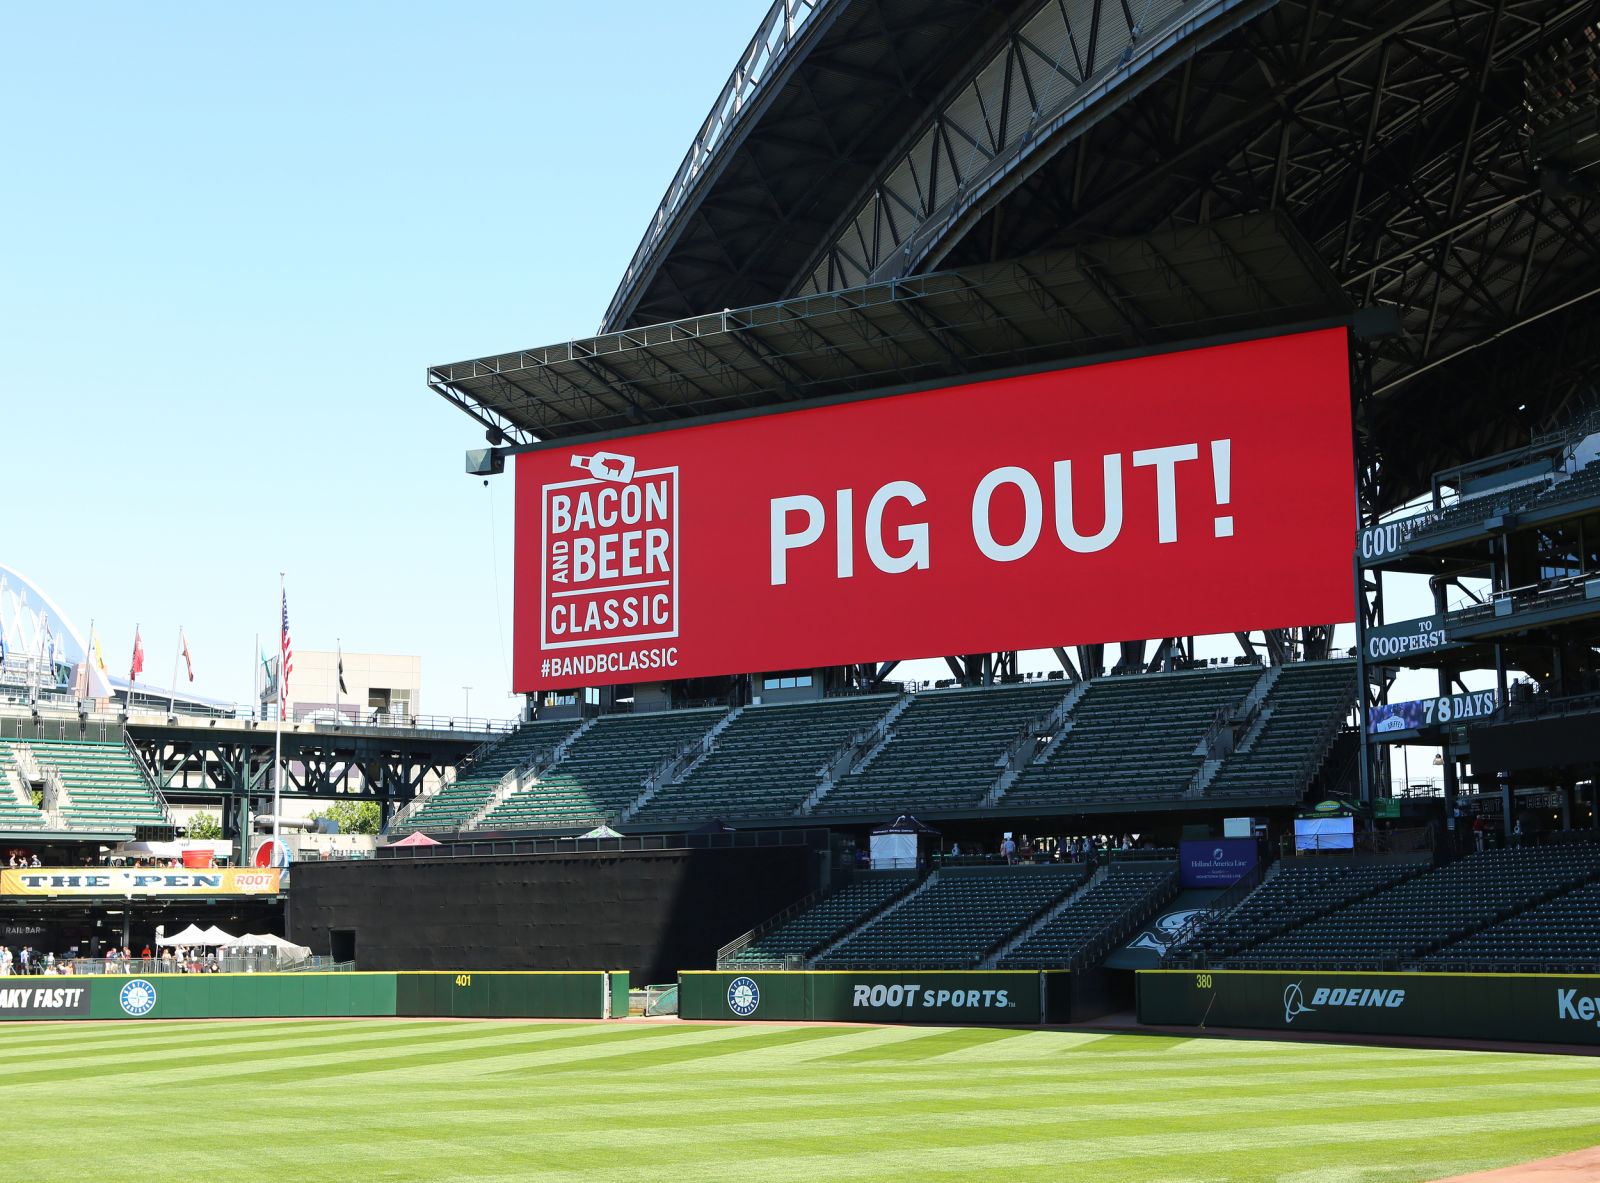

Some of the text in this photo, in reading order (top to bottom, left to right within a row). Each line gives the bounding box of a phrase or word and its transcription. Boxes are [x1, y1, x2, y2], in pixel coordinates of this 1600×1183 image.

[552, 480, 669, 534] BACON
[770, 438, 1235, 586] PIG OUT!
[552, 541, 569, 583] AND
[573, 528, 671, 582] BEER
[551, 593, 669, 635] CLASSIC
[1418, 620, 1433, 632] TO
[541, 647, 678, 678] #BANDBCLASSIC
[1423, 692, 1494, 724] 78 DAYS
[21, 873, 222, 887] THE 'PEN
[236, 875, 273, 886] ROOT
[5, 926, 41, 934] RAIL BAR
[455, 974, 472, 987] 401
[1196, 974, 1212, 989] 380
[33, 988, 81, 1008] FAST!
[853, 984, 921, 1008] ROOT
[922, 990, 1008, 1008] SPORTS
[1311, 988, 1406, 1008] BOEING
